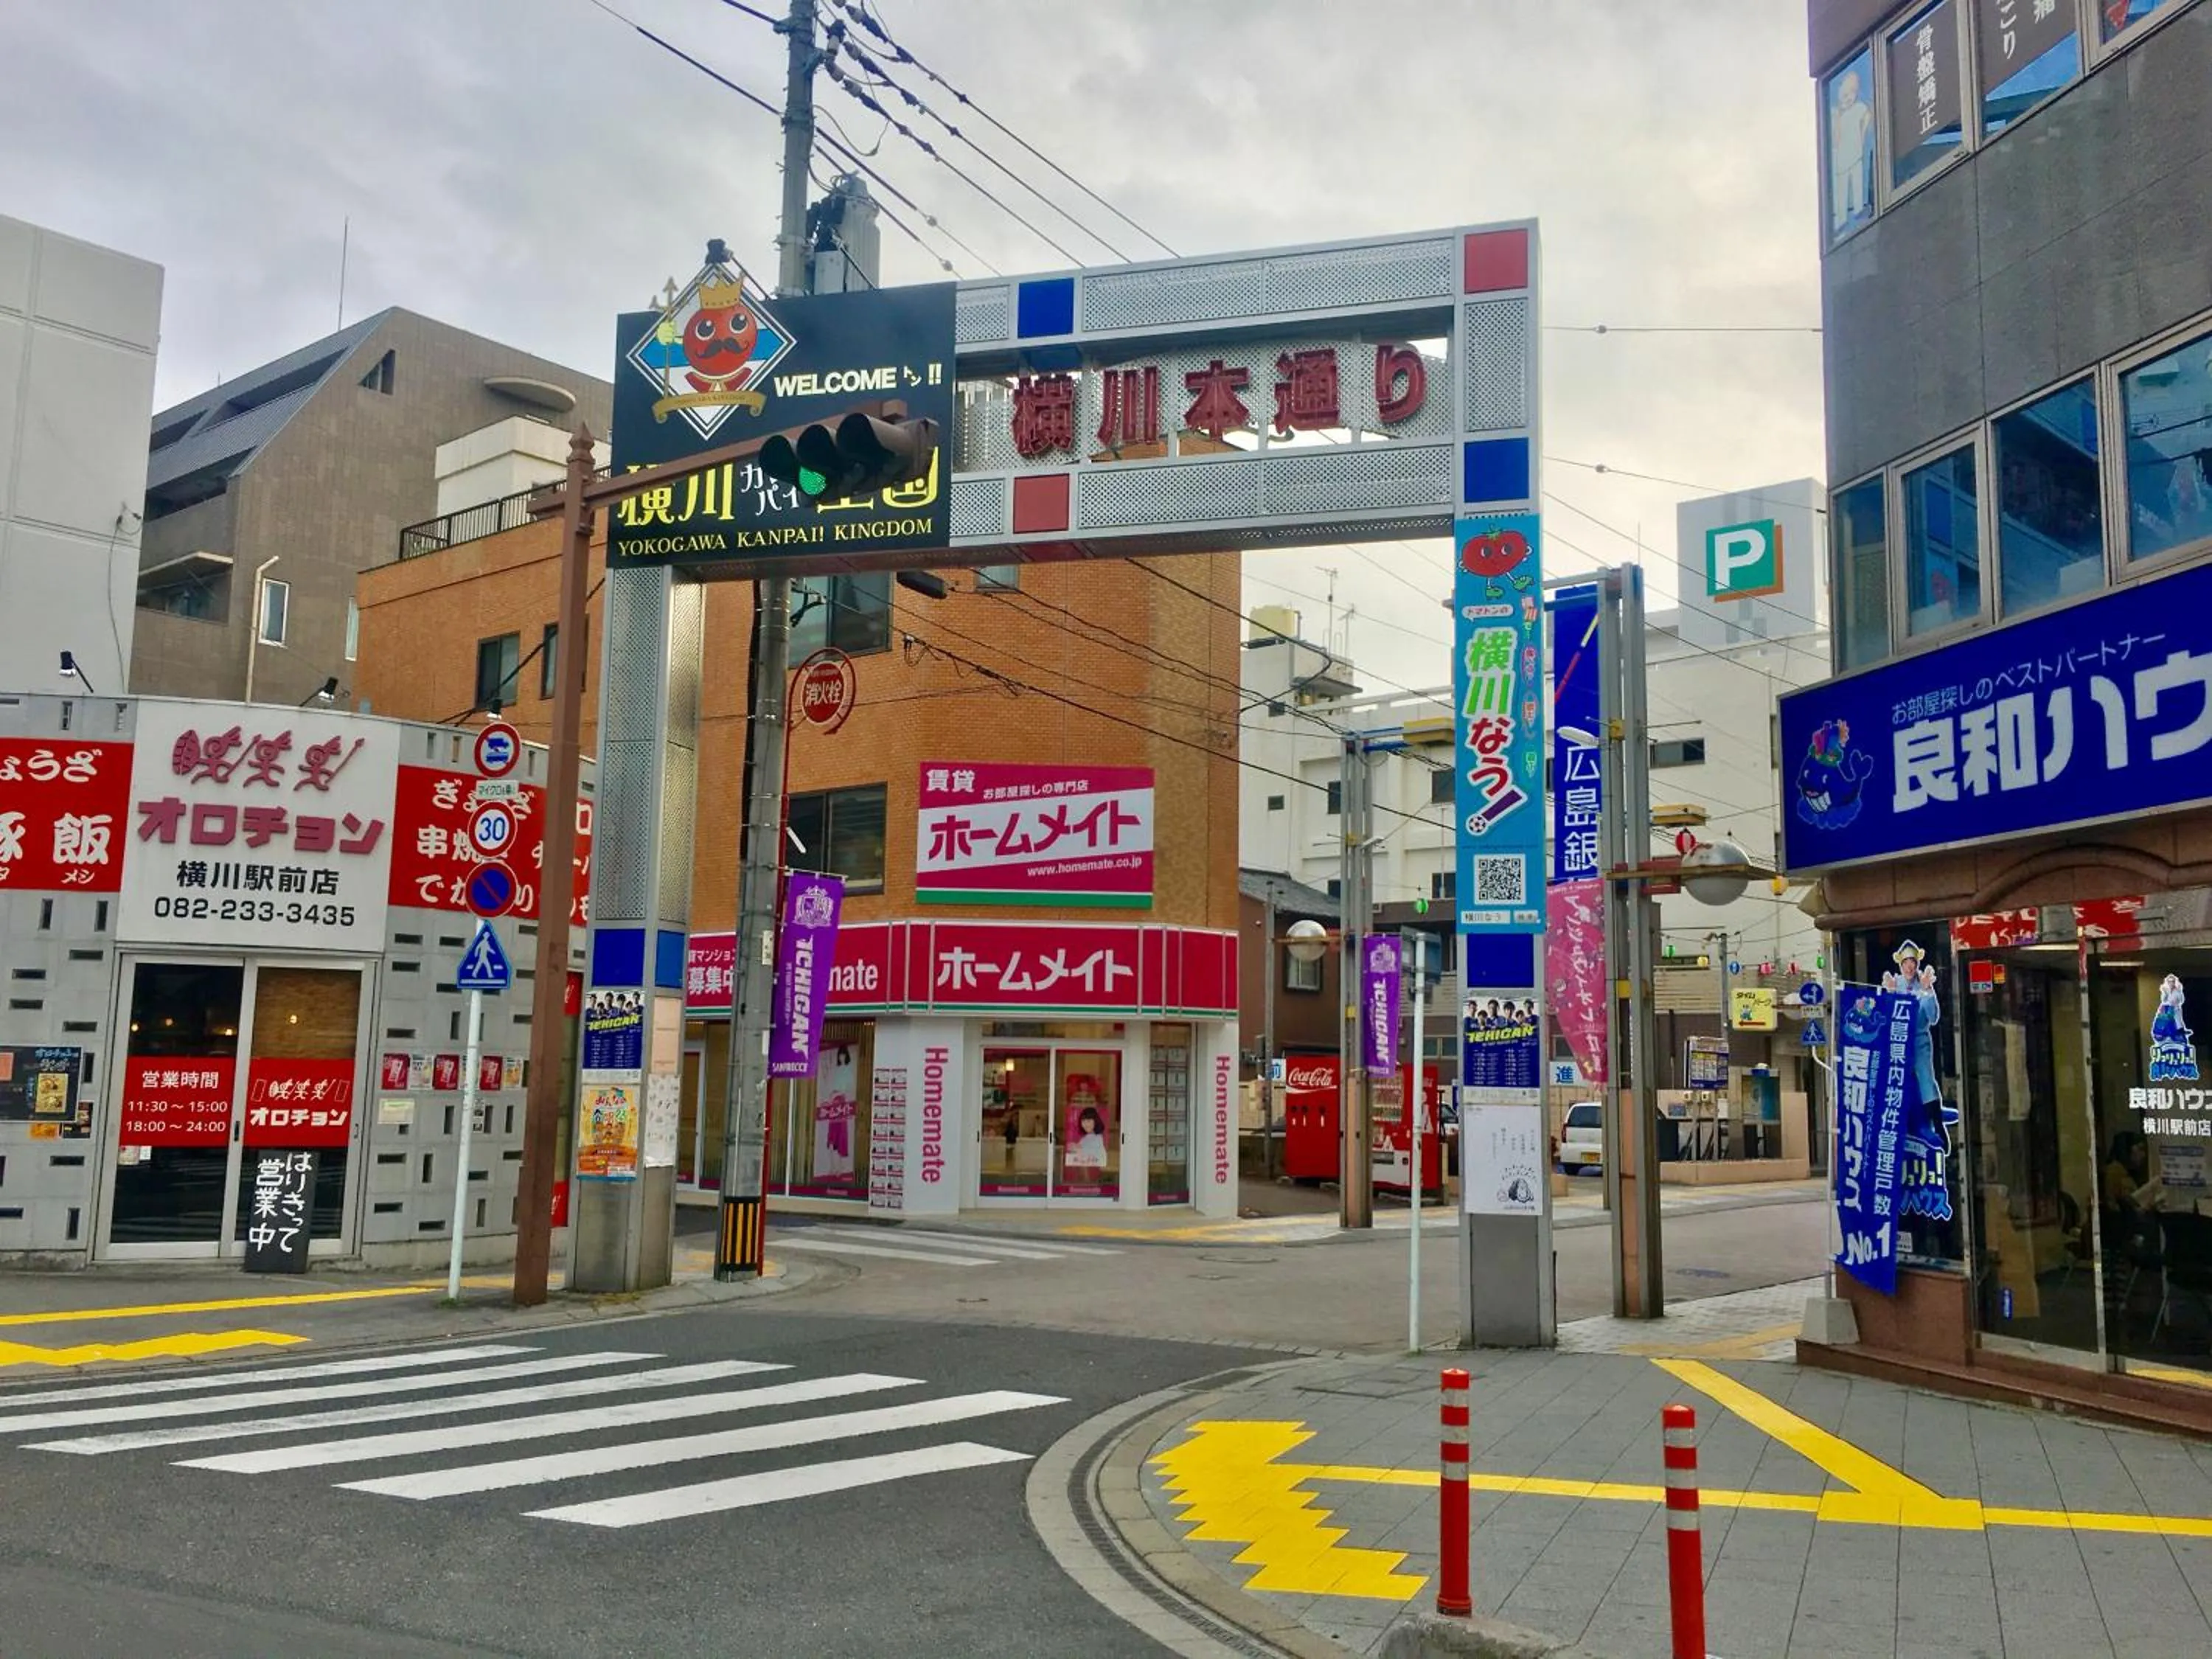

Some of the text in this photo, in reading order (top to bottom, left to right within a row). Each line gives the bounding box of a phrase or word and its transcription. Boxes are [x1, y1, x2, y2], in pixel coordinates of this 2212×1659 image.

[1916, 24, 1938, 135] 骨盤矯正
[773, 367, 897, 398] WELCOME
[1012, 344, 1427, 459] 横川本通り
[618, 518, 933, 557] YOKOGAWA KANPAI! KINGDOM
[1714, 528, 1767, 591] P
[805, 680, 842, 706] 消火栓
[1892, 633, 2166, 725] お部屋探しのベストパートナー
[927, 769, 975, 793] 賃貸
[983, 779, 1090, 800] お部屋探しの専門店
[138, 797, 385, 855] オロチョン
[479, 817, 506, 842] 30
[928, 800, 1141, 861] ホームメイト
[1564, 745, 1601, 883] 広島銀
[176, 860, 340, 895] 横川駅前店
[1027, 855, 1143, 877] www.homemate.co.jp
[154, 896, 355, 928] 082-233-3435
[937, 946, 1134, 992] ホームメイト
[142, 1071, 219, 1090] 営業時間
[128, 1100, 167, 1113] 11:30
[189, 1100, 228, 1113] 15:00
[249, 1107, 348, 1127] オロチョン
[920, 1047, 949, 1184] Homemate
[1214, 1055, 1231, 1185] Homemate
[126, 1121, 166, 1133] 18:00
[186, 1121, 226, 1133] 24:00
[2143, 1116, 2211, 1137] 横川駅前店
[248, 1158, 285, 1253] 営業中
[278, 1152, 313, 1253] はりきって
